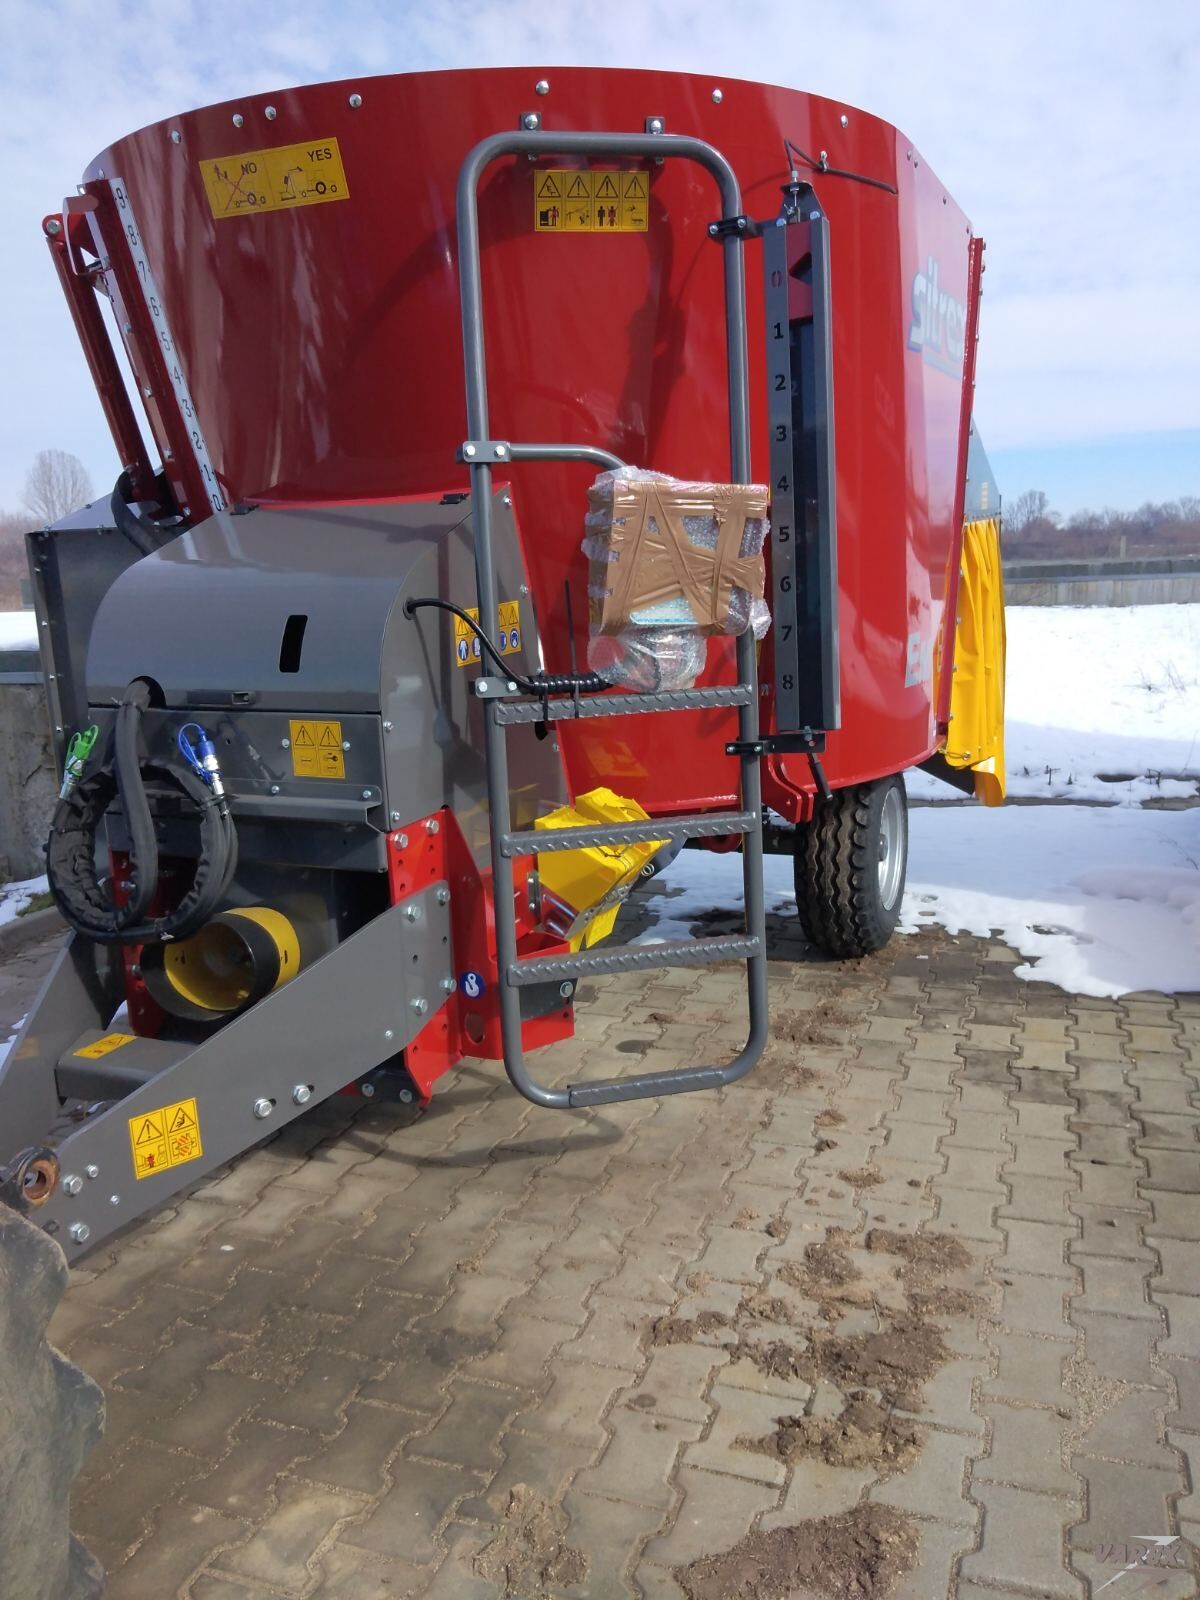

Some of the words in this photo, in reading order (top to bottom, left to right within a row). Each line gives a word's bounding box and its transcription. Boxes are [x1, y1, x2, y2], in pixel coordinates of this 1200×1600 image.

[307, 148, 333, 162] YES
[241, 162, 257, 176] NO
[115, 187, 126, 209] 9
[127, 224, 137, 246] 8
[138, 260, 147, 282] 7
[771, 270, 782, 288] 0
[150, 296, 159, 317] 6
[773, 322, 784, 340] 1
[161, 331, 171, 351] 5
[173, 366, 182, 384] 4
[775, 374, 786, 391] 2
[182, 399, 191, 418] 3
[192, 431, 202, 450] 2
[776, 425, 787, 442] 3
[203, 463, 211, 481] 1
[777, 475, 789, 492] 4
[212, 494, 221, 512] 0
[779, 526, 790, 543] 5
[780, 575, 791, 593] 6
[781, 625, 793, 641] 7
[782, 674, 794, 691] 8
